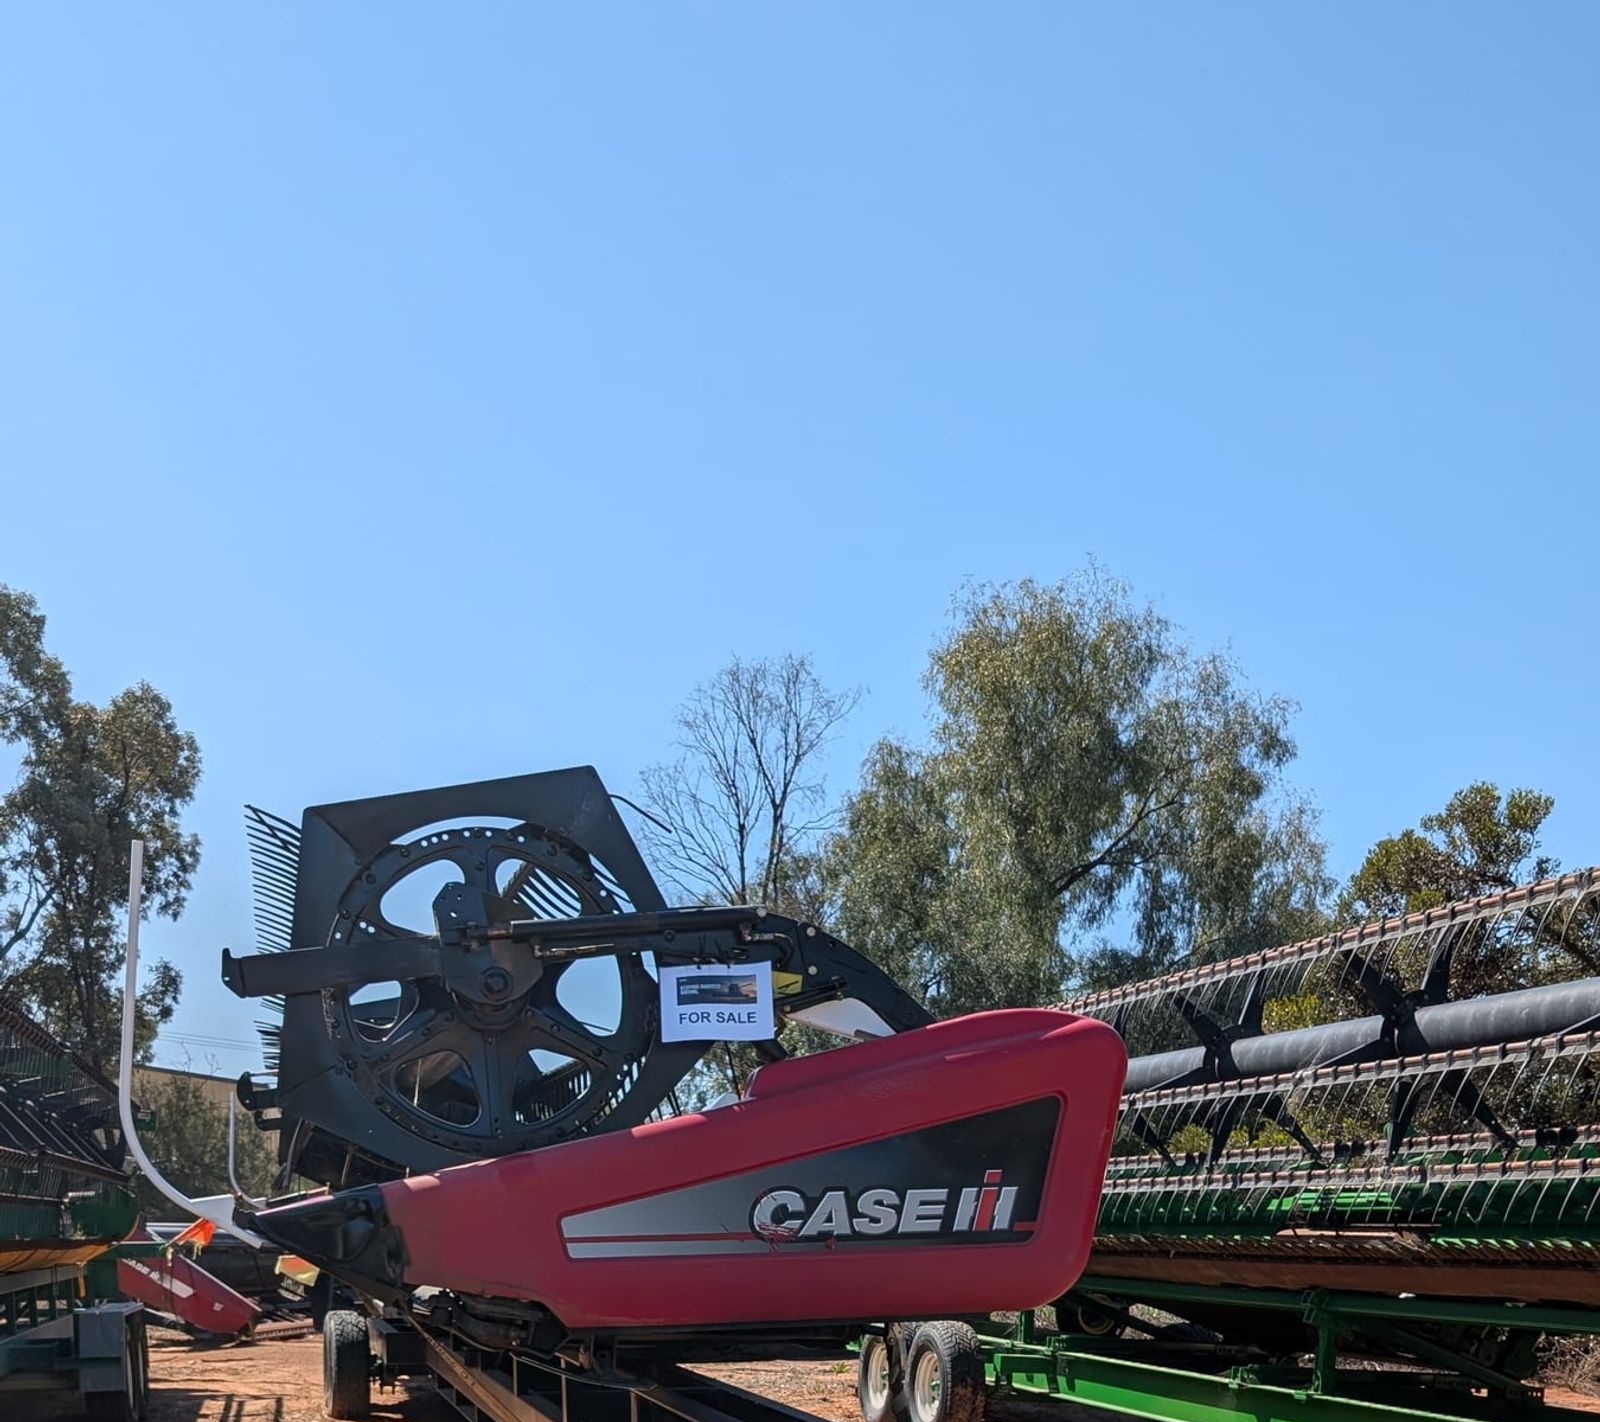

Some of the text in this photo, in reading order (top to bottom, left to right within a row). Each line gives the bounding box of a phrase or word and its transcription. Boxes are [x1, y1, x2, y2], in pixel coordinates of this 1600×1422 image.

[679, 1011, 757, 1025] FOR SALE
[753, 1188, 949, 1239] CASE
